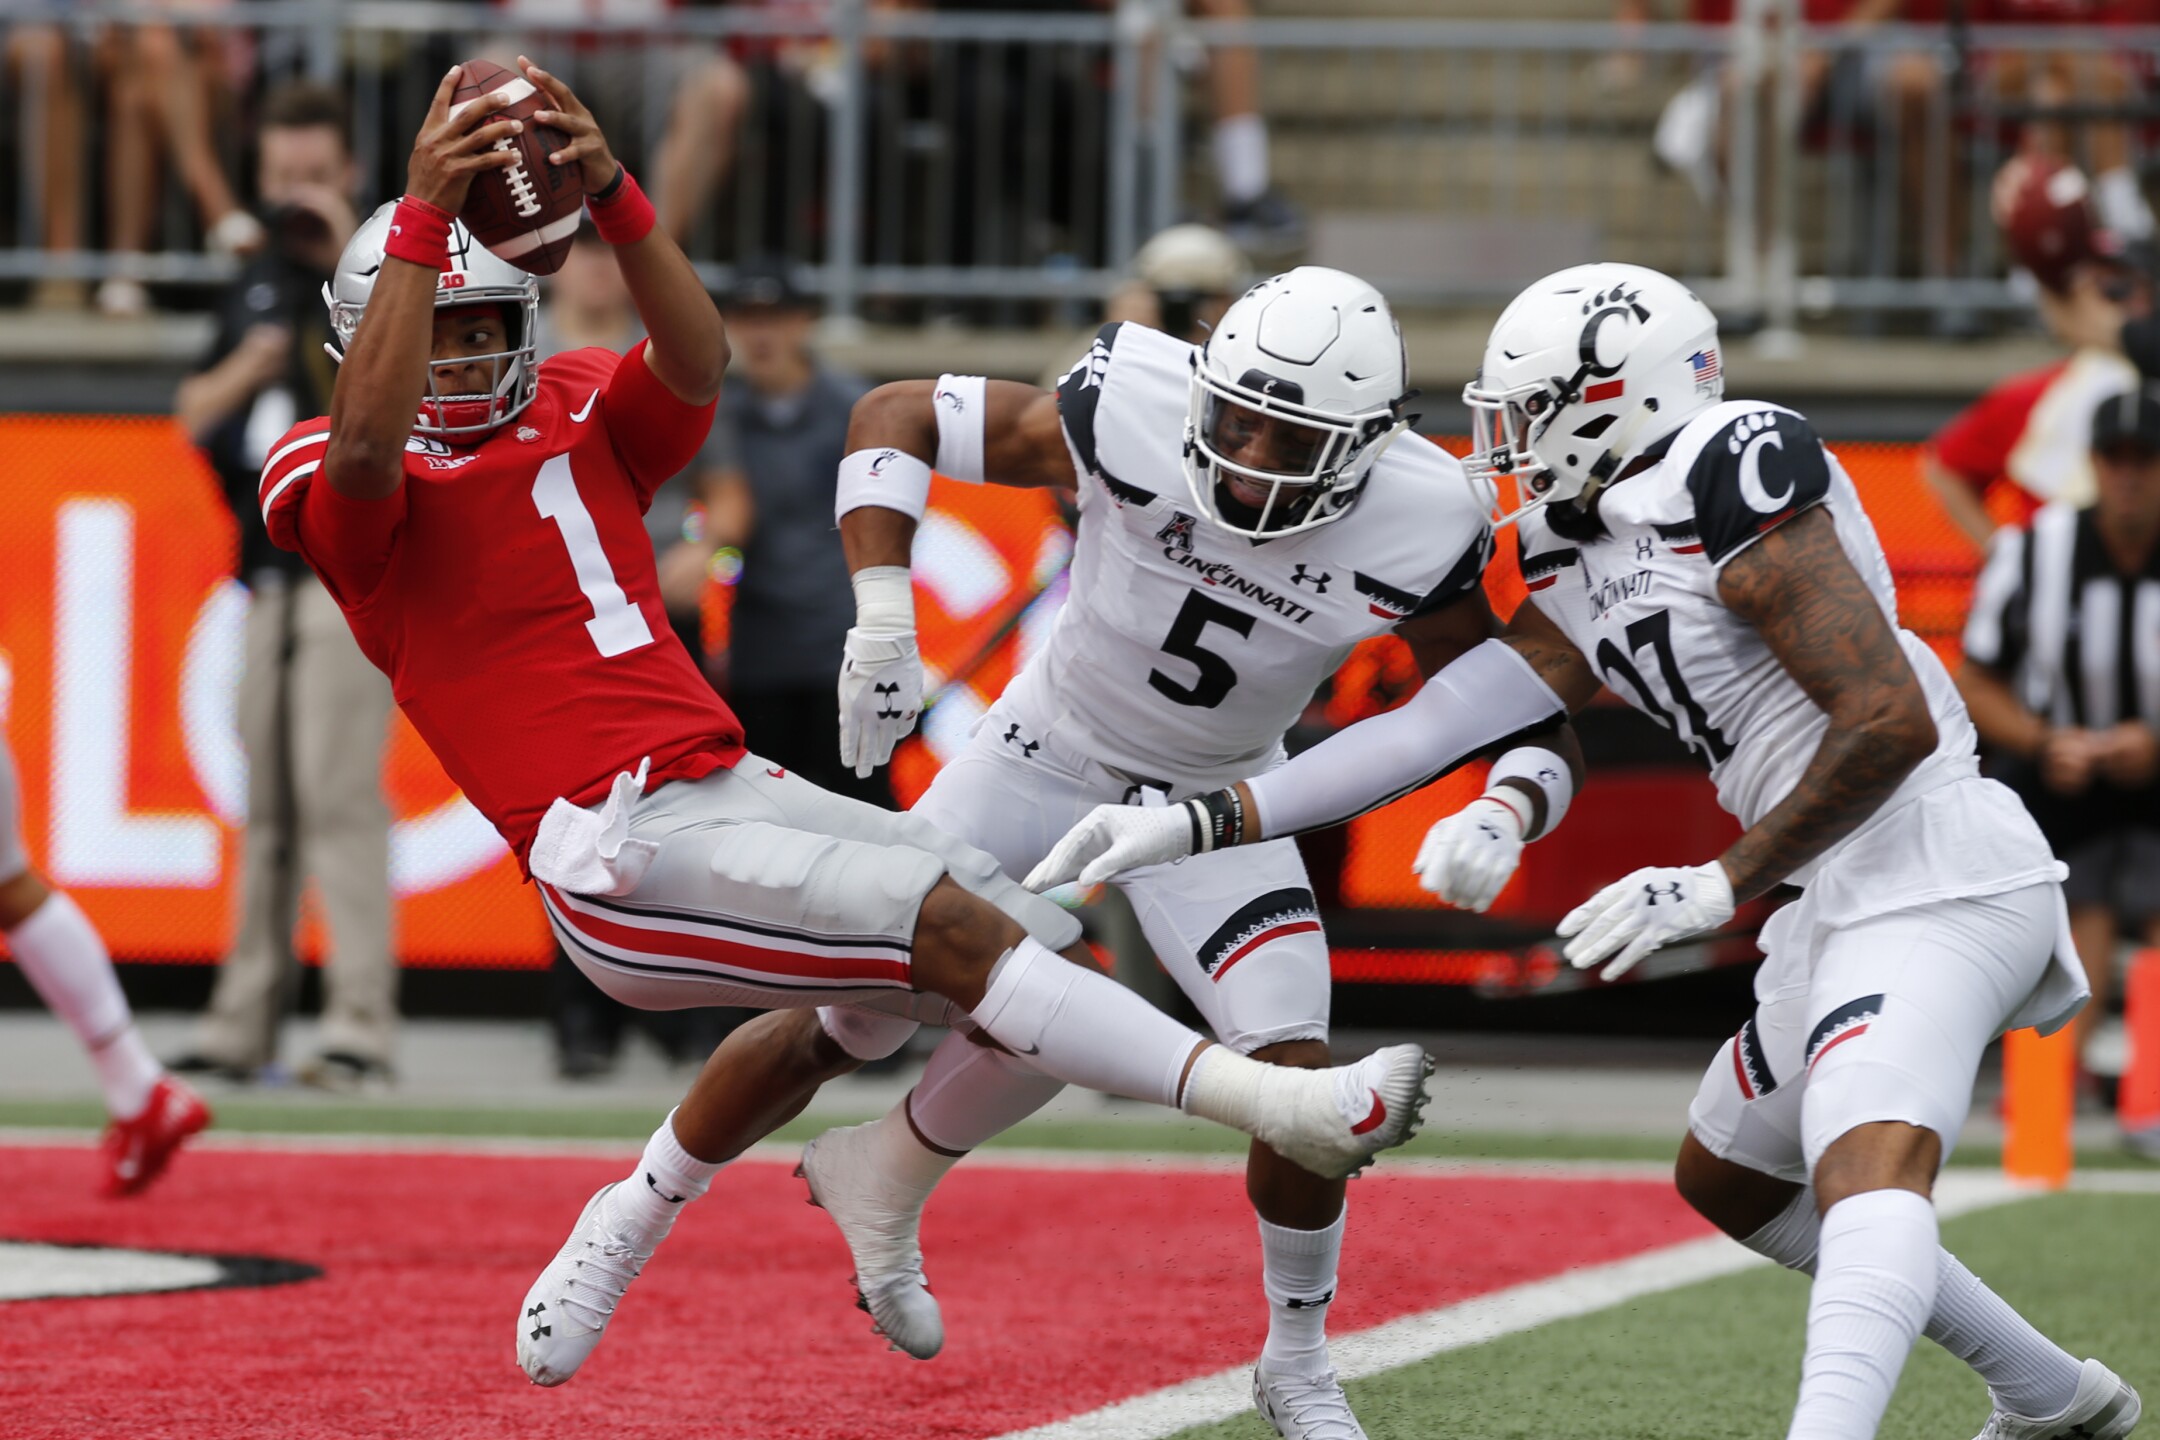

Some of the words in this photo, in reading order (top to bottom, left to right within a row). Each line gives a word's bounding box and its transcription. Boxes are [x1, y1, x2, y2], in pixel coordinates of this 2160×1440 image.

[531, 452, 655, 658] 1
[1163, 547, 1314, 625] CINCINNATI
[1147, 587, 1258, 709] 5
